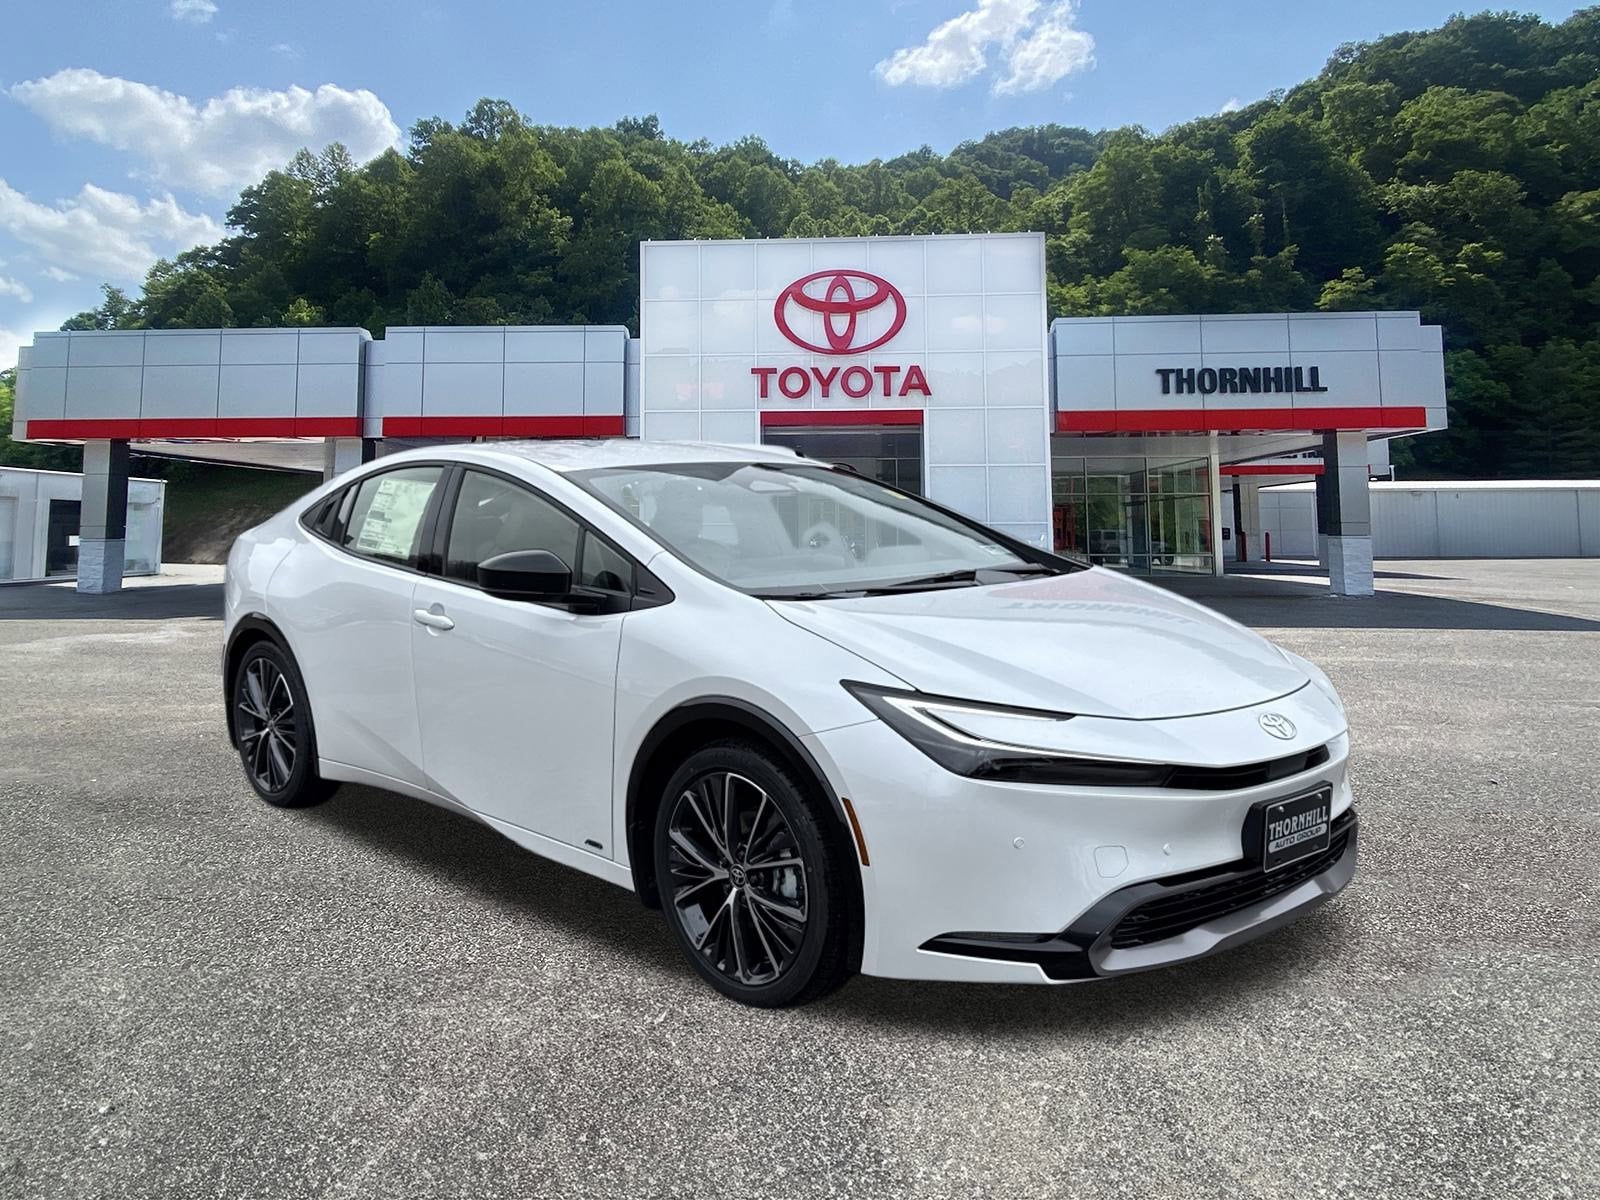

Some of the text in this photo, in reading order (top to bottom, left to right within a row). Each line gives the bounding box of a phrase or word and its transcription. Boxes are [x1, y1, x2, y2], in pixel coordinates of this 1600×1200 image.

[751, 365, 932, 399] TOYOTA
[1155, 366, 1328, 394] THORNHILL
[1269, 805, 1328, 840] THORNHILL
[1274, 826, 1322, 849] AUTO GROUP
